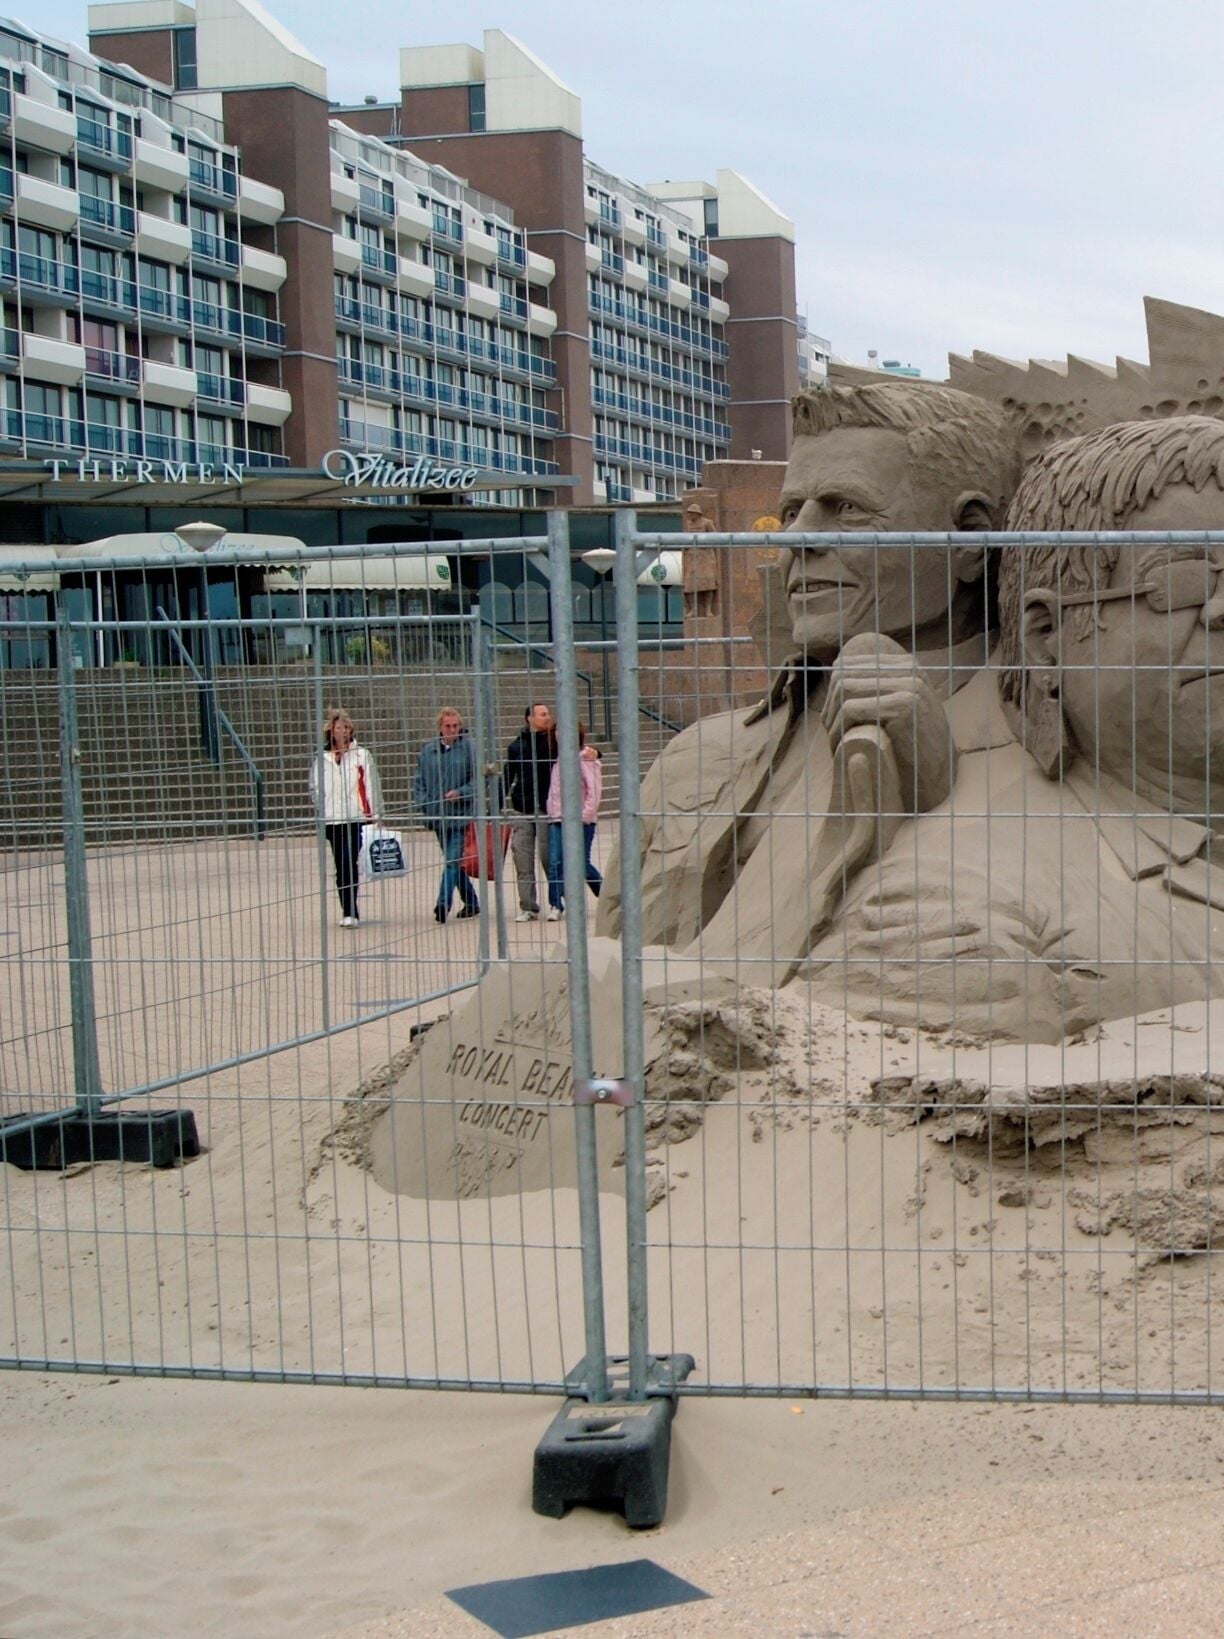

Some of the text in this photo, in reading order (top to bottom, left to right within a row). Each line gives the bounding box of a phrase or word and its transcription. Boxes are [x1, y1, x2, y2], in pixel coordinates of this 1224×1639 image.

[44, 449, 478, 489] THERMEN Vitalizee
[445, 1044, 580, 1101] ROYAL BEA
[459, 1098, 549, 1141] CONCERT
